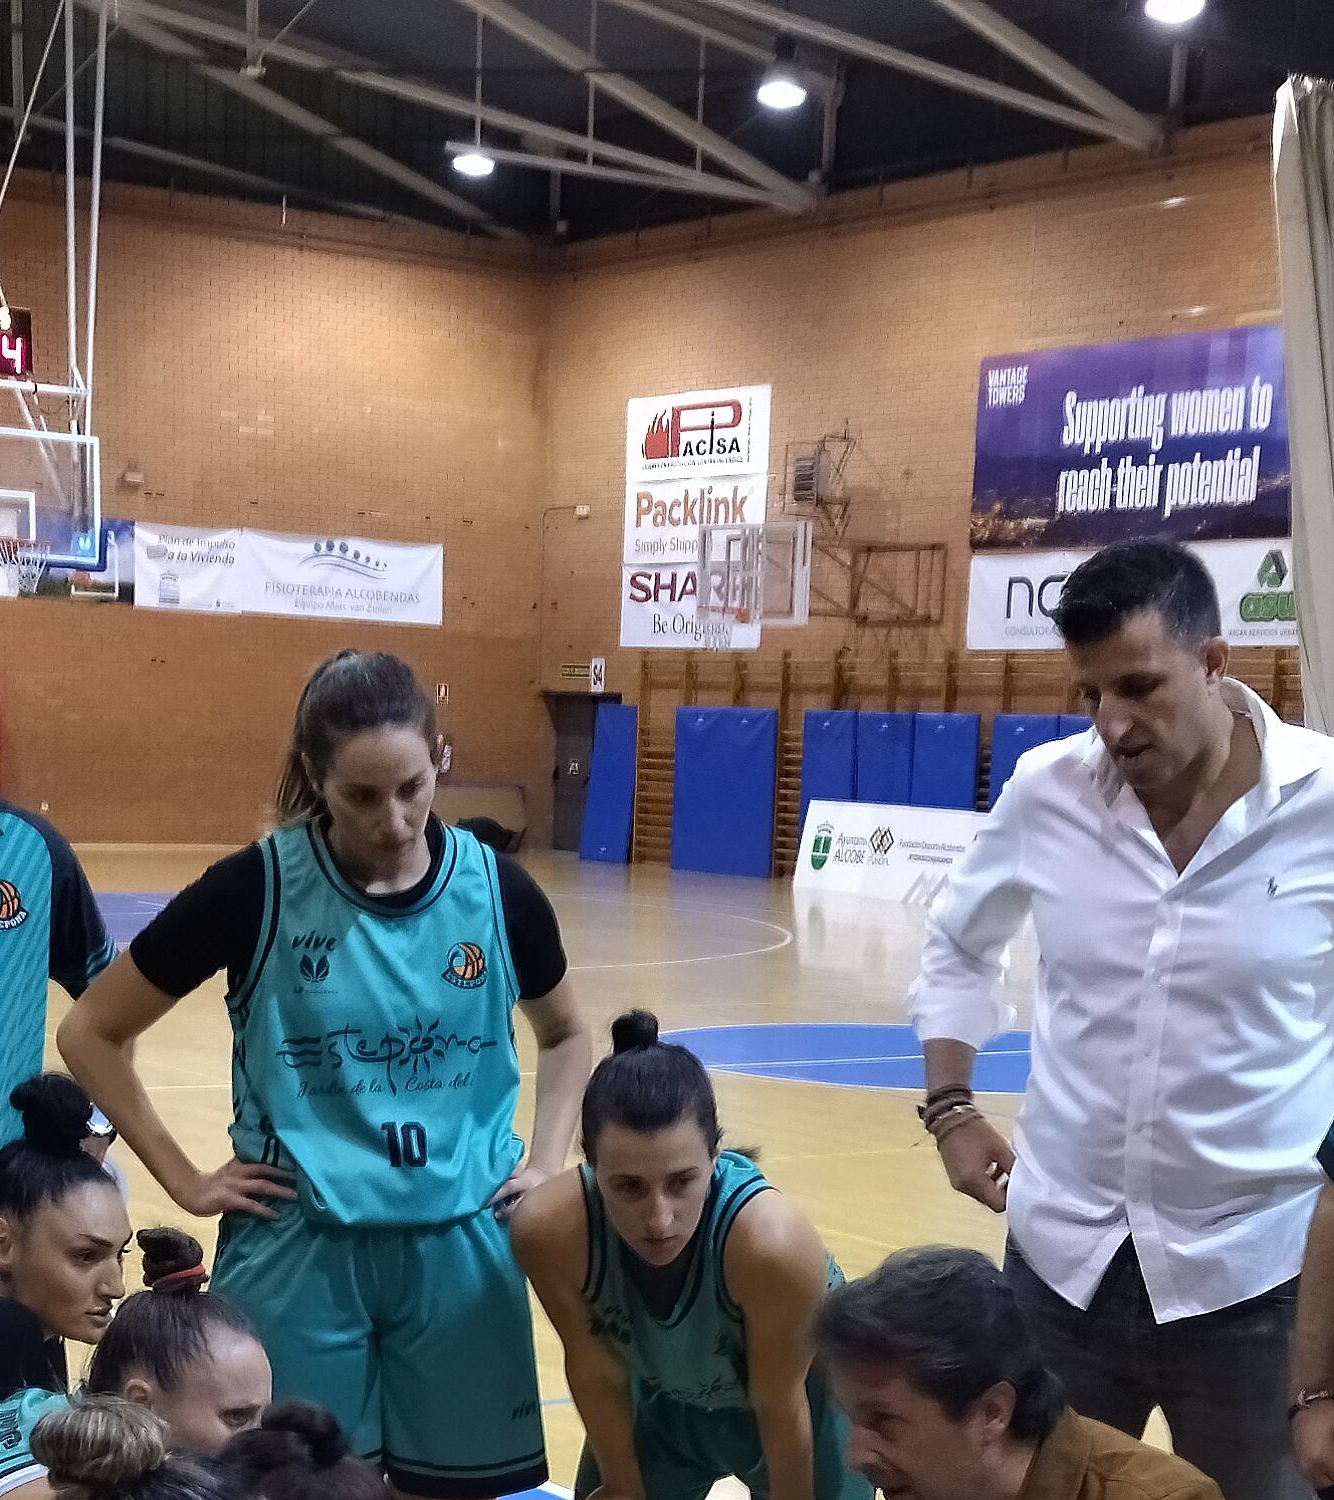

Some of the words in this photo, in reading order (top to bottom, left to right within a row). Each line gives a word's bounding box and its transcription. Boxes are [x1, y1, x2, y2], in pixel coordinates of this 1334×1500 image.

[986, 366, 1029, 387] VANTAGE
[986, 385, 1025, 407] TOWERS
[1062, 385, 1167, 455] Supporting
[1171, 386, 1246, 436] women
[1250, 375, 1273, 430] to
[1057, 458, 1112, 512] reach
[1116, 454, 1164, 510] their
[1164, 445, 1261, 517] potential
[635, 485, 748, 528] Packlink
[634, 539, 667, 555] Simply
[670, 537, 698, 555] Shipp
[190, 552, 235, 565] Vivienda
[265, 582, 342, 598] FISIOTERAPIA
[345, 588, 420, 604] ALCOBENDAS
[652, 613, 668, 634] Be
[381, 1121, 428, 1168] 10
